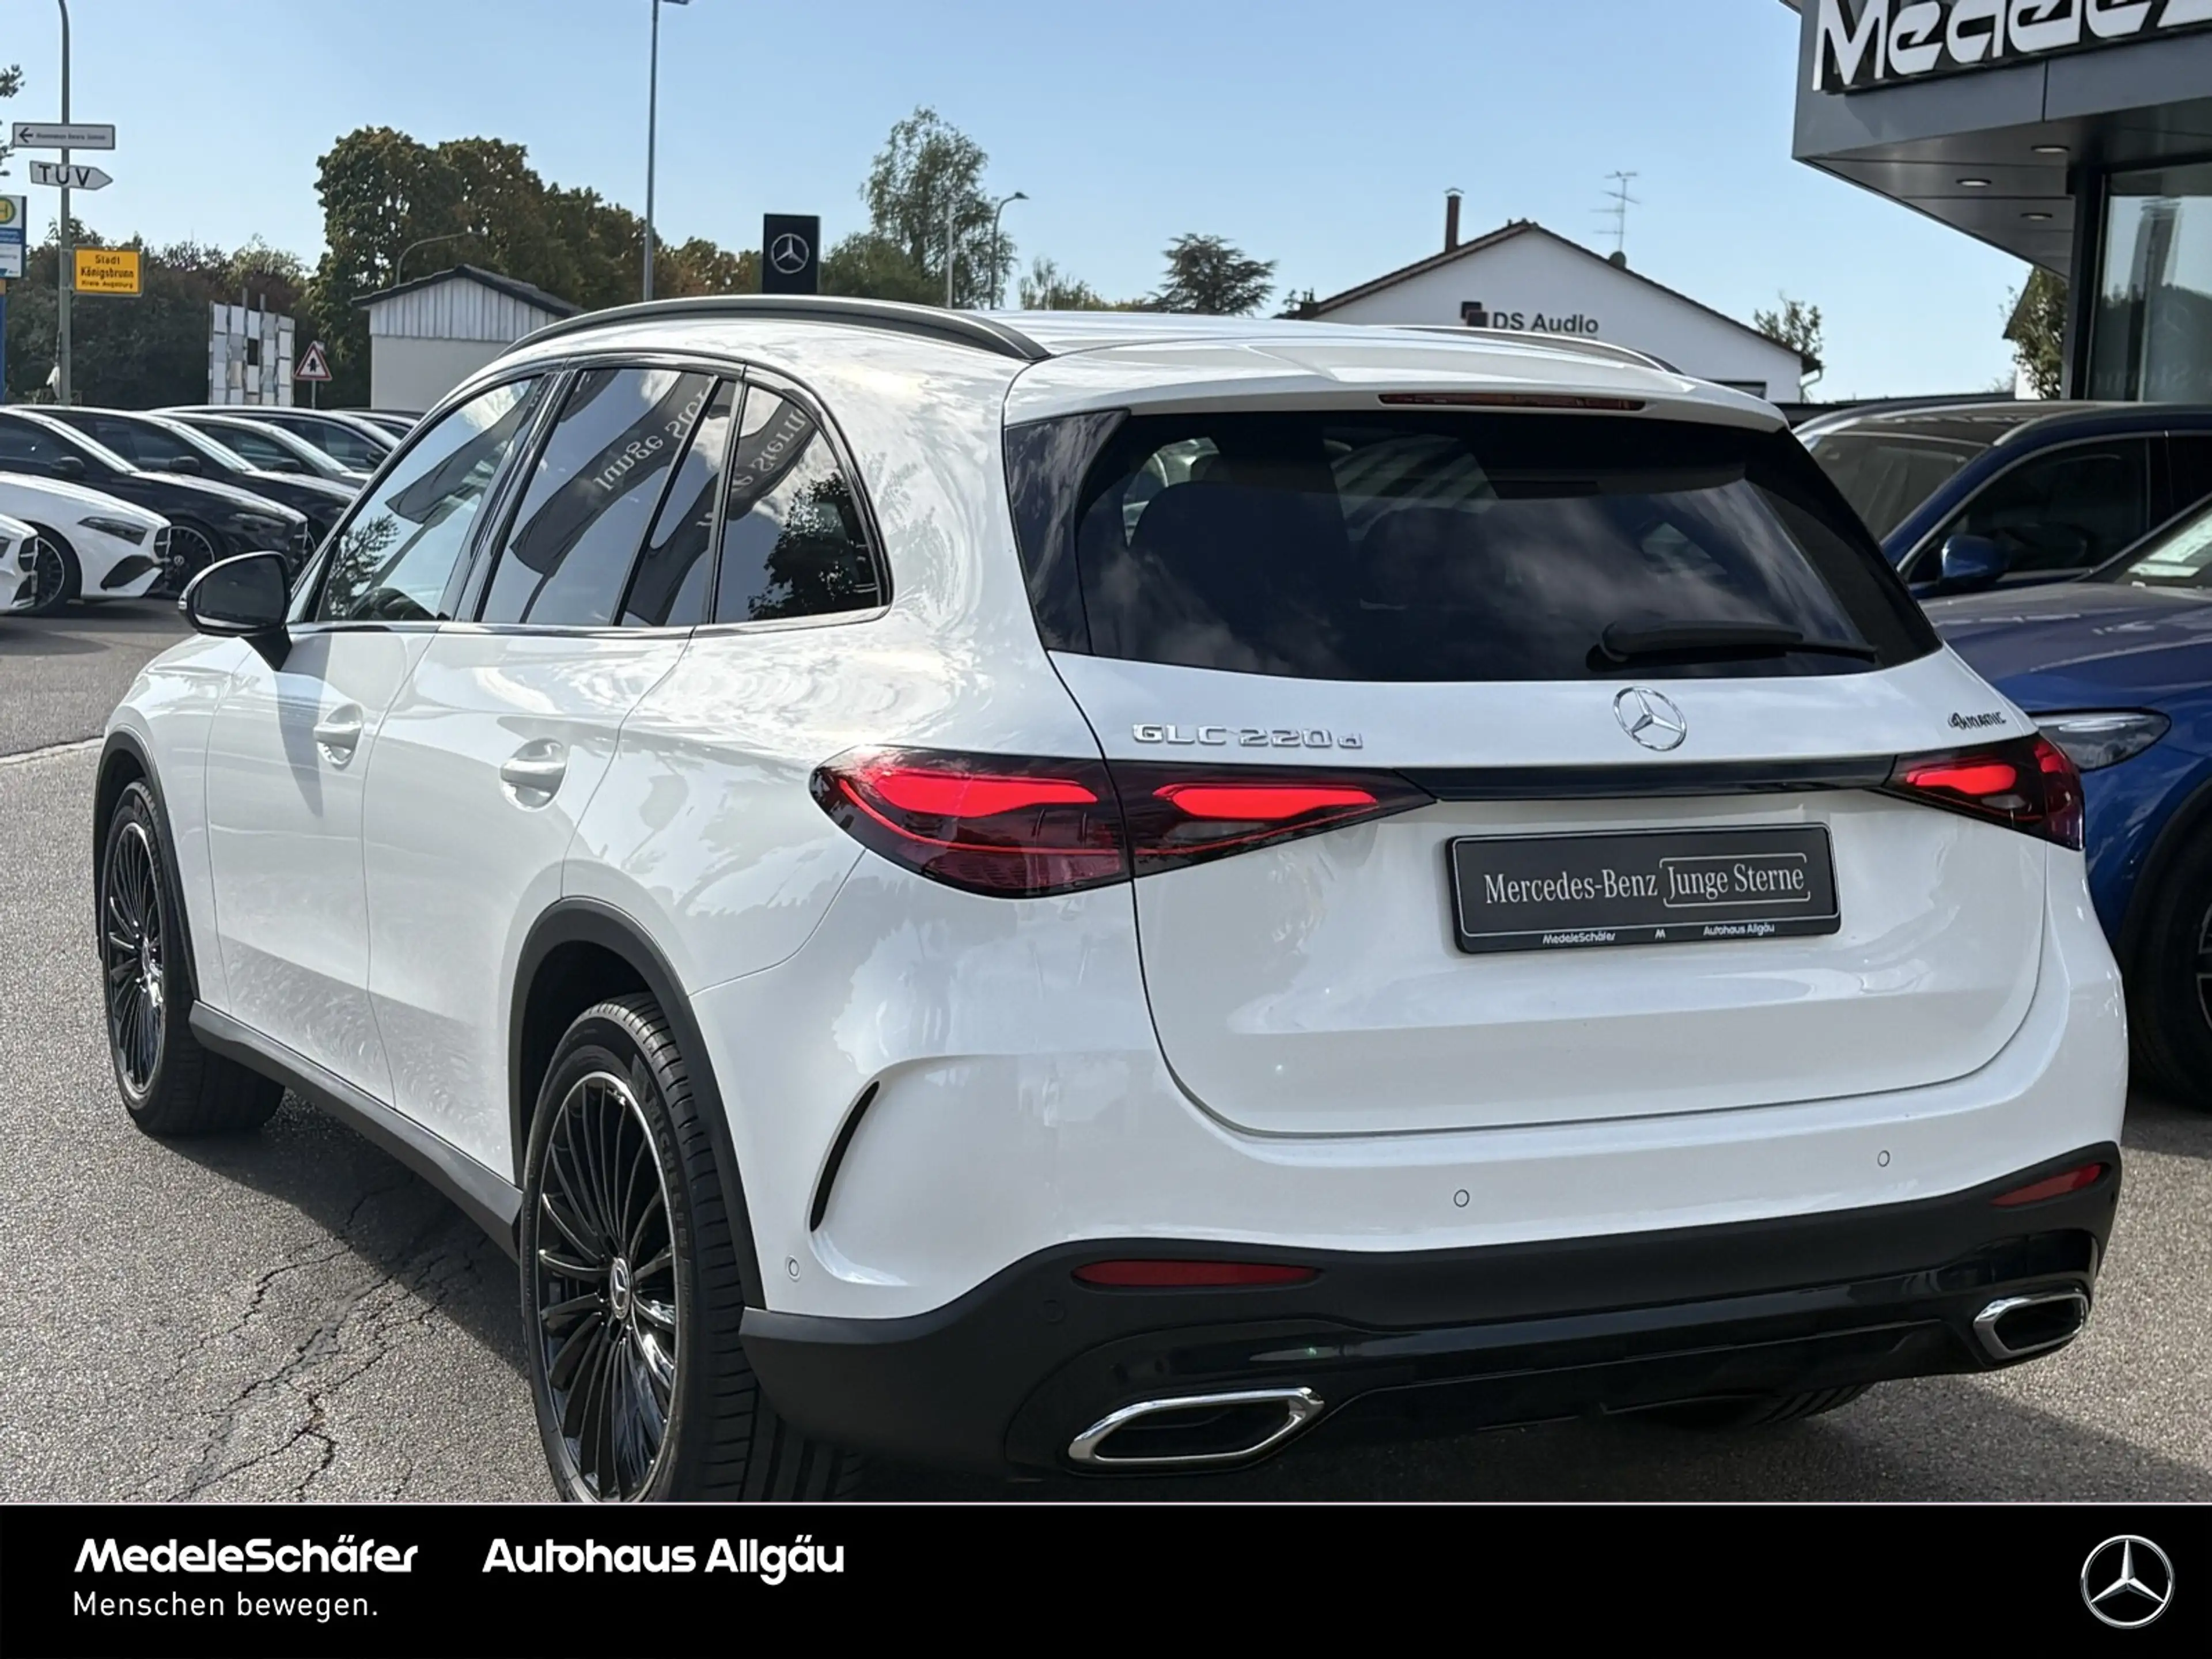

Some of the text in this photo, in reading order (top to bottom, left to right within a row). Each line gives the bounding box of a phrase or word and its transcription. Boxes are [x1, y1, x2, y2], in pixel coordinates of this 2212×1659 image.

[95, 255, 120, 264] Stadt
[81, 266, 134, 279] Königsbrunn
[1493, 312, 1599, 334] DS Audio
[1132, 723, 1226, 745] GLC
[1483, 862, 1804, 905] Mercedes-Benz Junge Sterne
[1542, 931, 1616, 945] MedeleSchäfer
[1703, 924, 1746, 936] Autohaus
[1747, 922, 1775, 935] Allgäu
